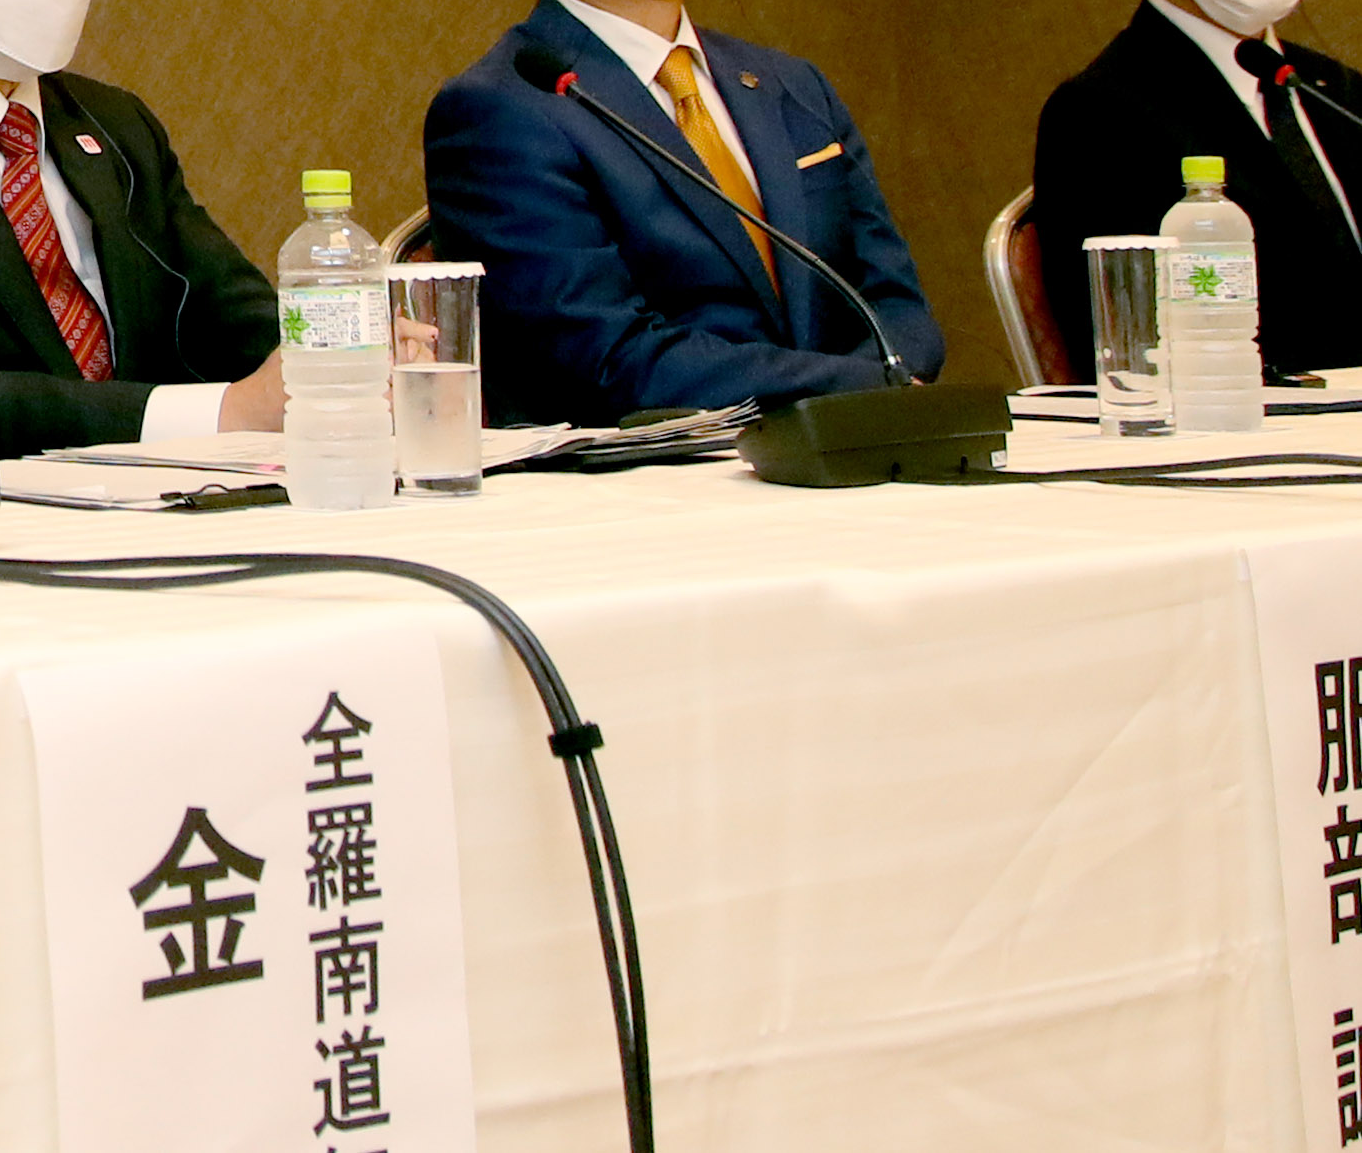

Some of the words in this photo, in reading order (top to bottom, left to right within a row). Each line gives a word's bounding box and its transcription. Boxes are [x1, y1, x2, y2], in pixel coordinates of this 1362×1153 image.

[128, 806, 266, 1001] 金
[301, 691, 391, 1153] 全羅南道
